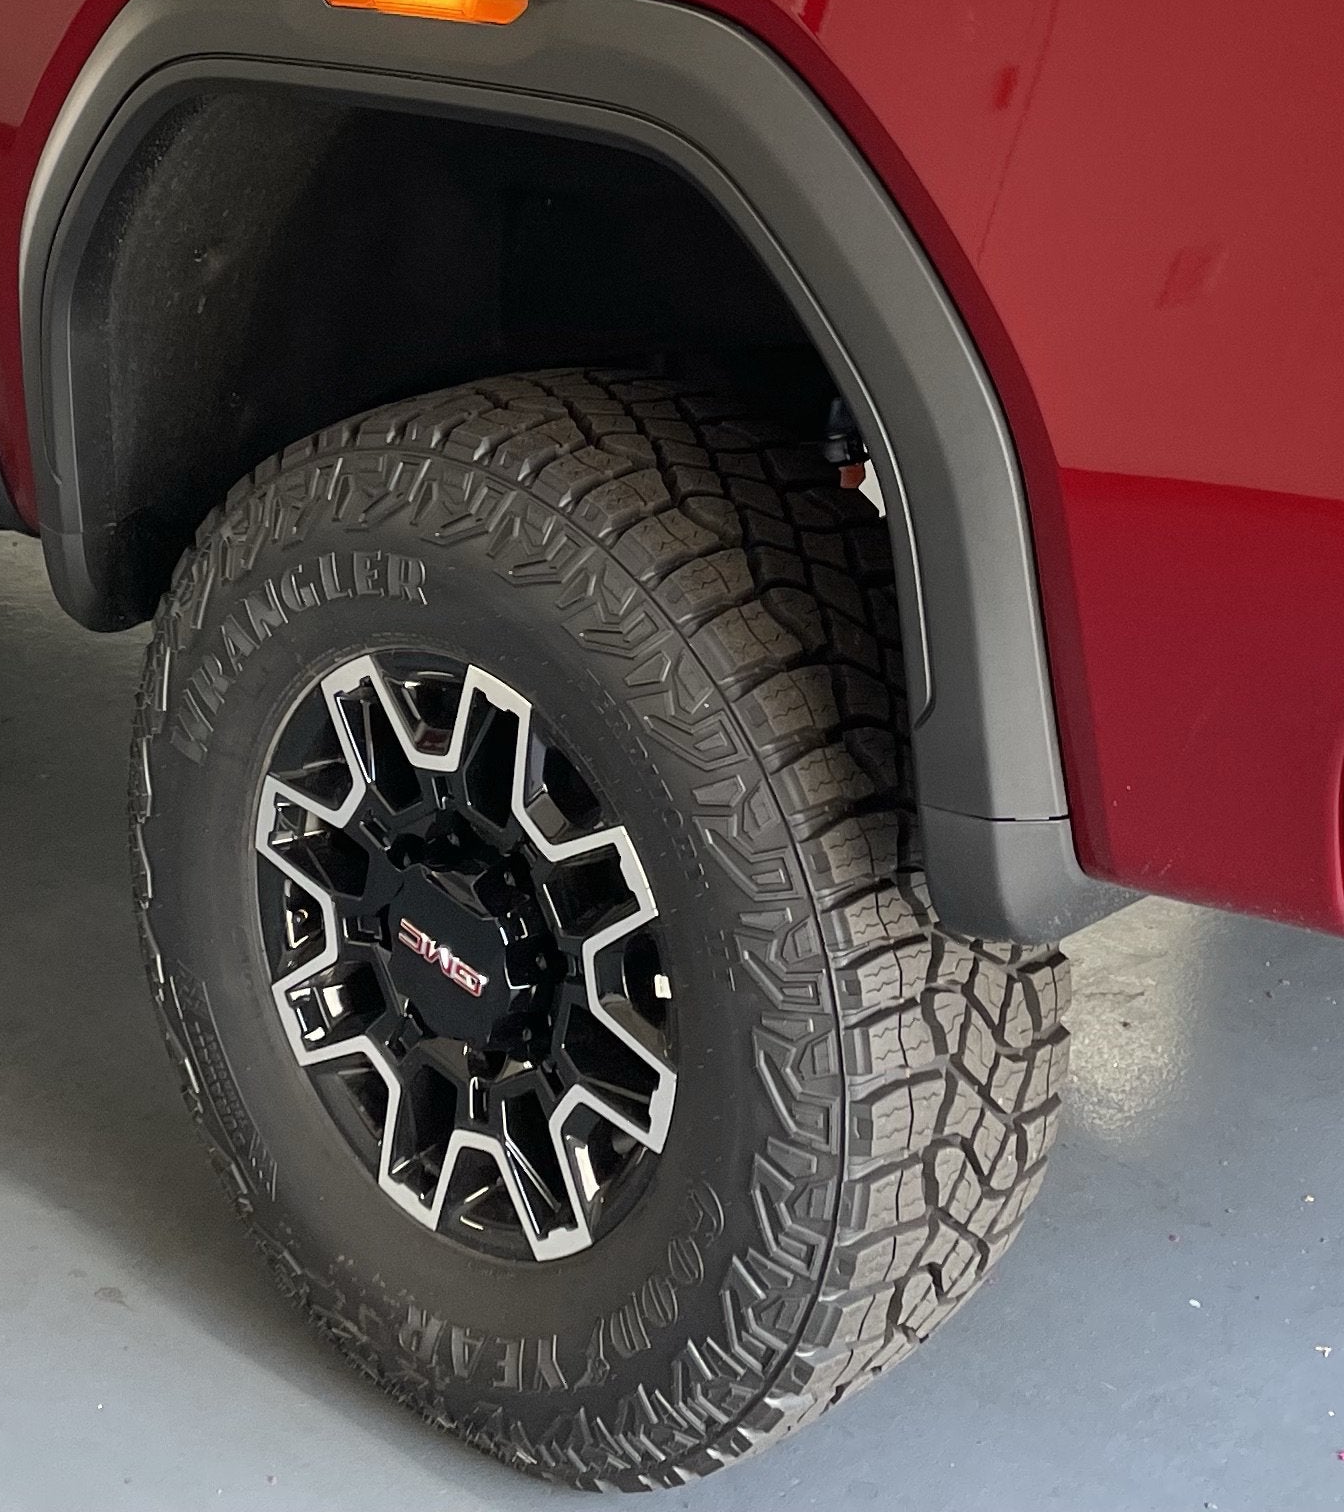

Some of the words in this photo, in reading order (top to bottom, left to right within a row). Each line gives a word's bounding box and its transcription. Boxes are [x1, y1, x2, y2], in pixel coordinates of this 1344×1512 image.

[170, 550, 428, 765] WRANGLER
[398, 917, 489, 997] GMC
[397, 1182, 725, 1393] GOODYEAR
